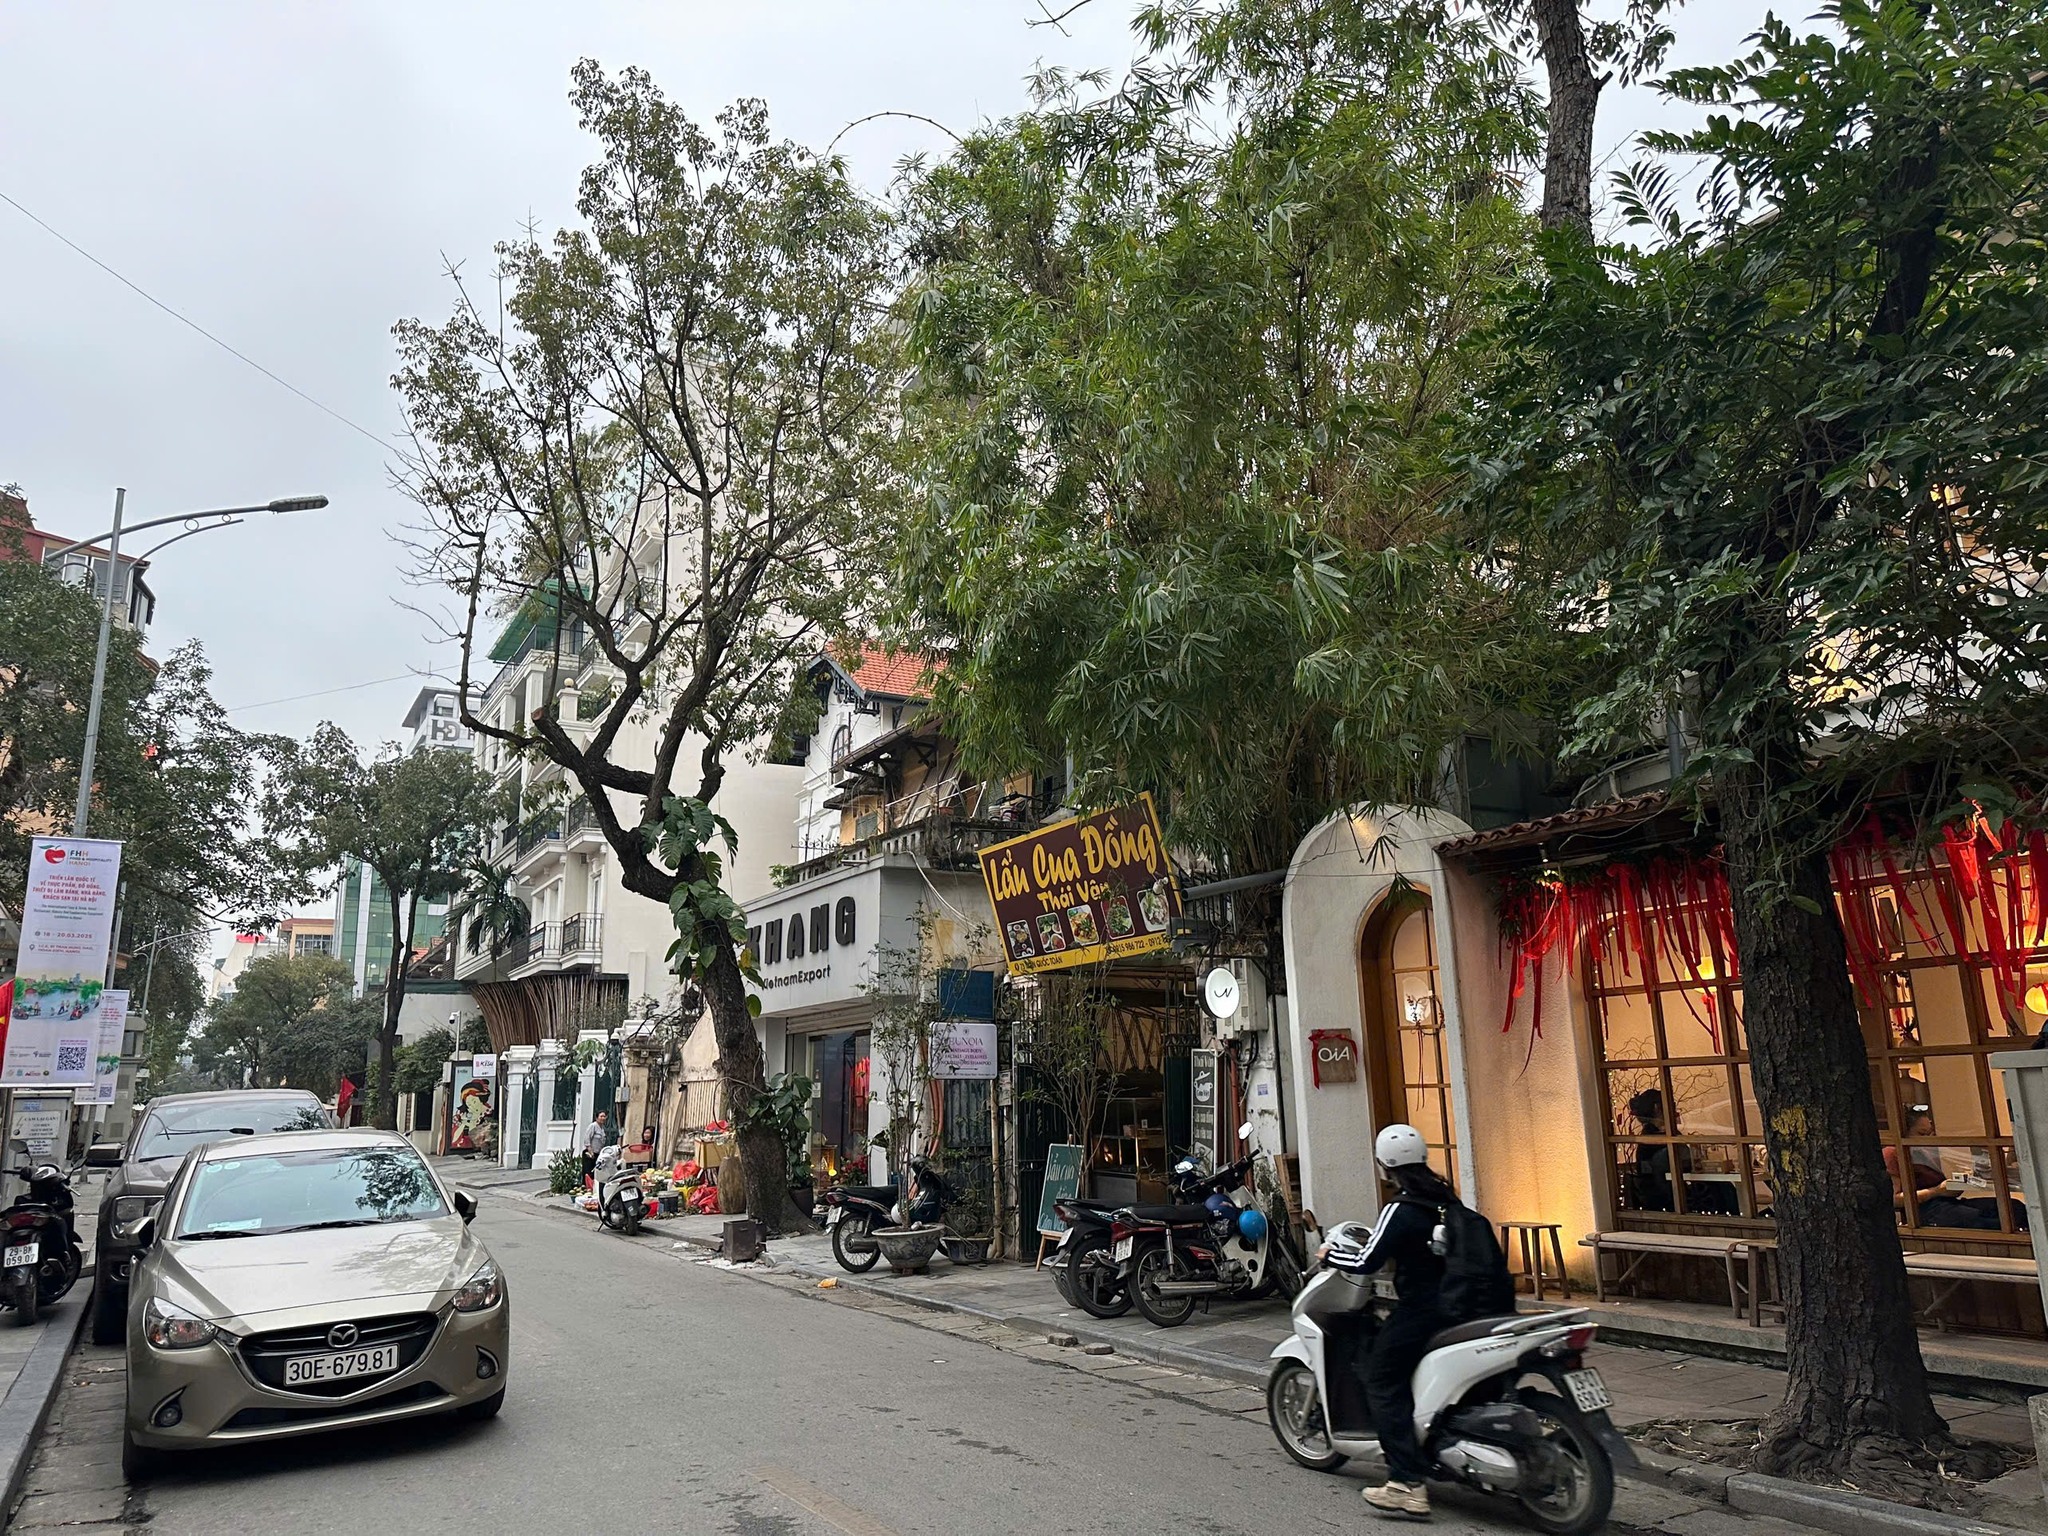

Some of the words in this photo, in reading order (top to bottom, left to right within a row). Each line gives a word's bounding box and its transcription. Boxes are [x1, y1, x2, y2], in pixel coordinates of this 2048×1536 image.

[990, 849, 1030, 901] Lẩu
[1032, 843, 1081, 889] Cua
[1079, 813, 1158, 874] Đồng
[1036, 884, 1075, 913] Thái
[288, 1348, 394, 1381] 30E-679.81
